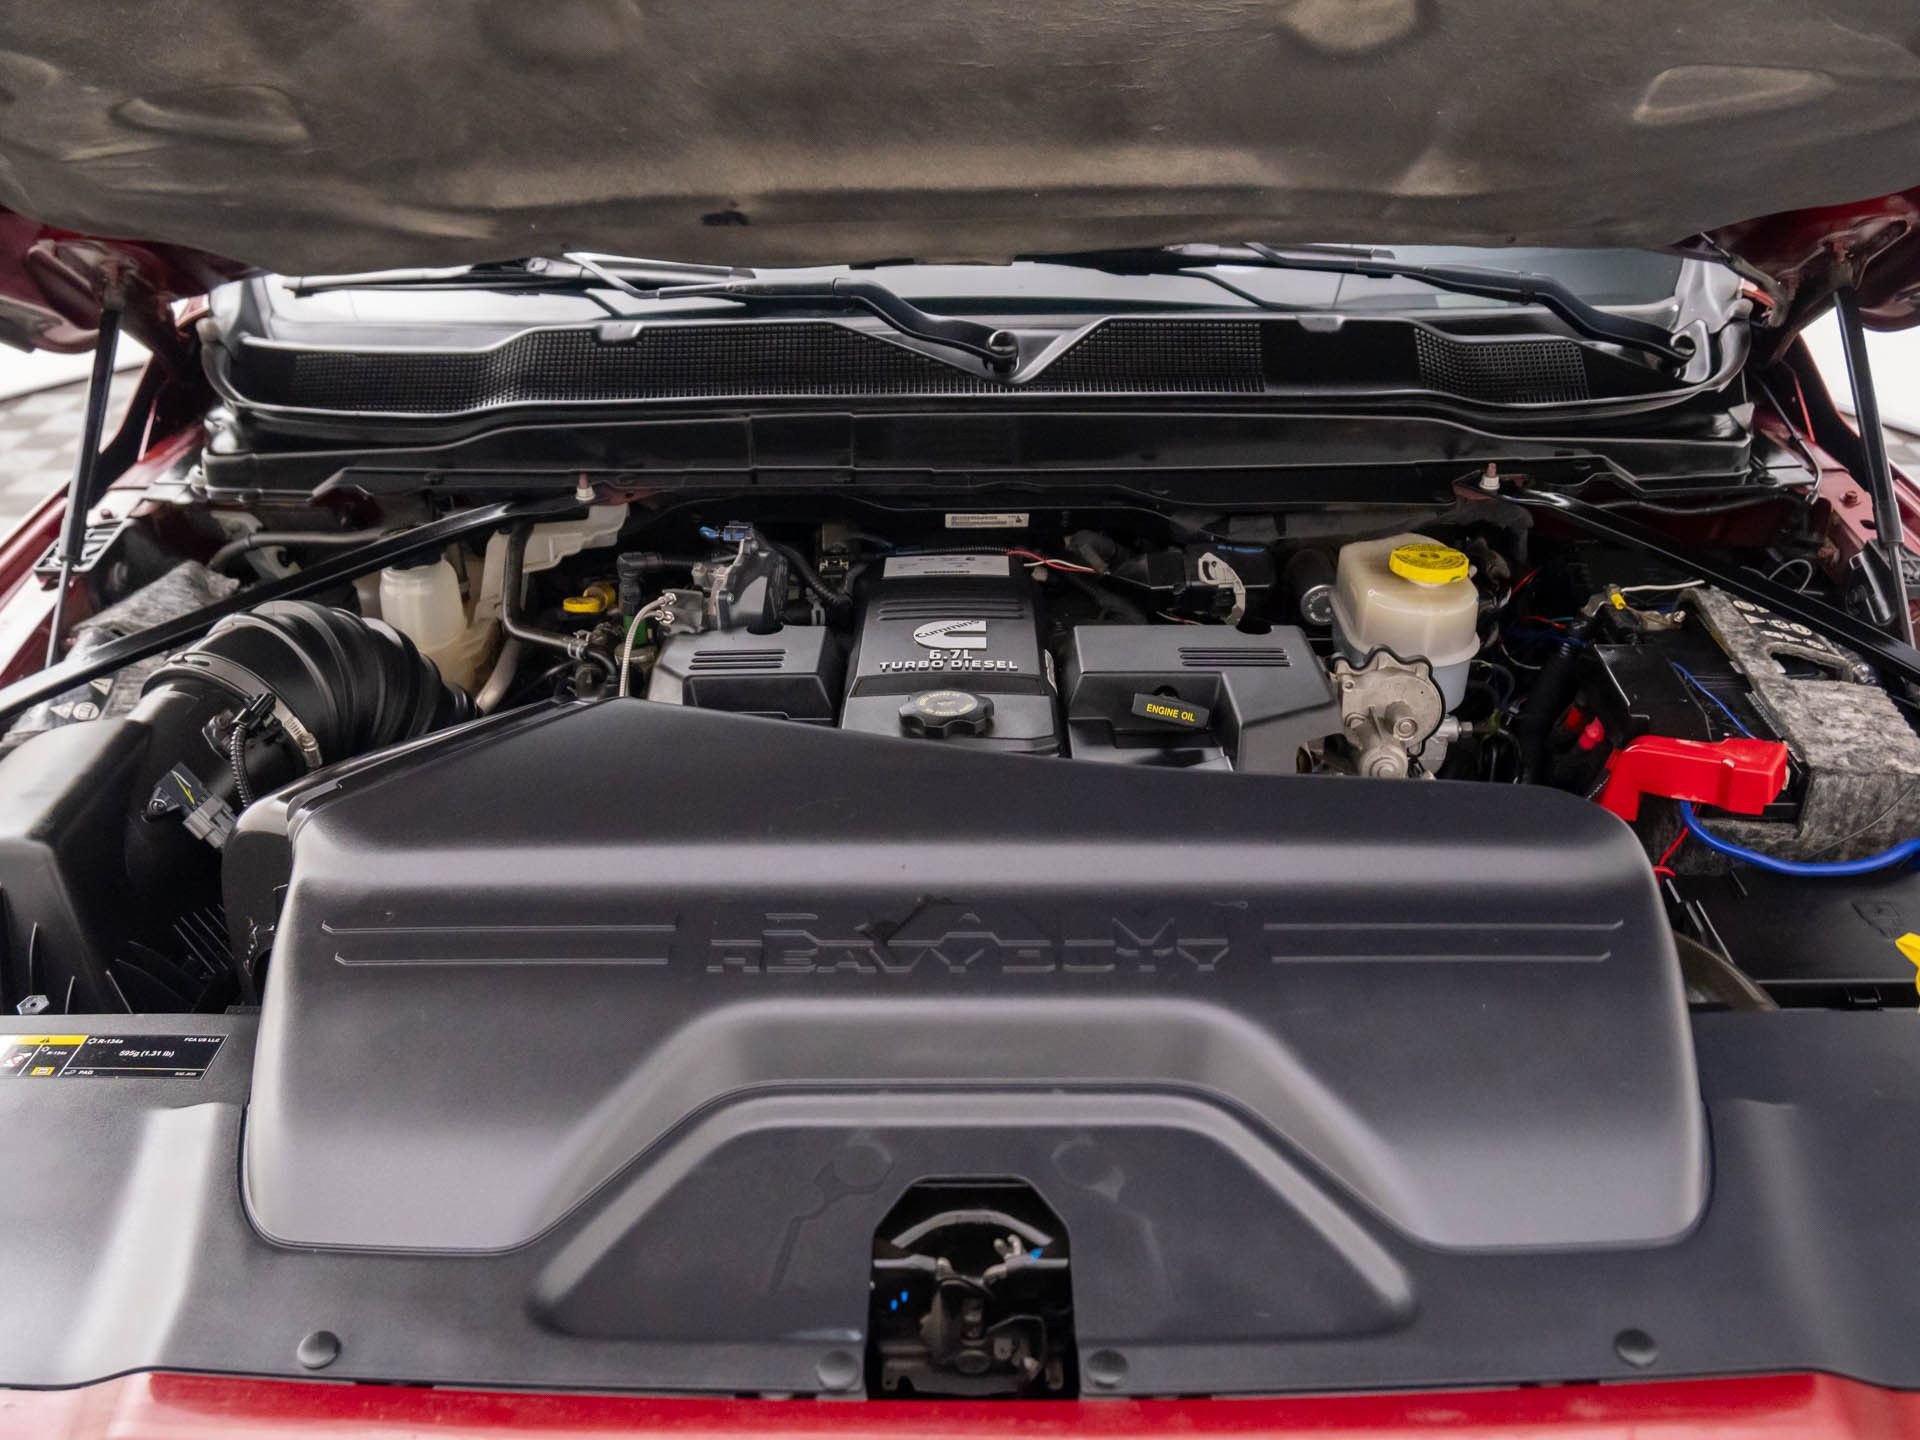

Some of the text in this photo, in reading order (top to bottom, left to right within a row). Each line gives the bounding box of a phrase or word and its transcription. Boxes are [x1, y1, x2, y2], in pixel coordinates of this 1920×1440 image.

[929, 649, 973, 660] 6.7L
[880, 660, 1018, 671] TURBO DIESEL
[1146, 703, 1195, 722] ENGINE OIL
[706, 946, 985, 974] HEAVY
